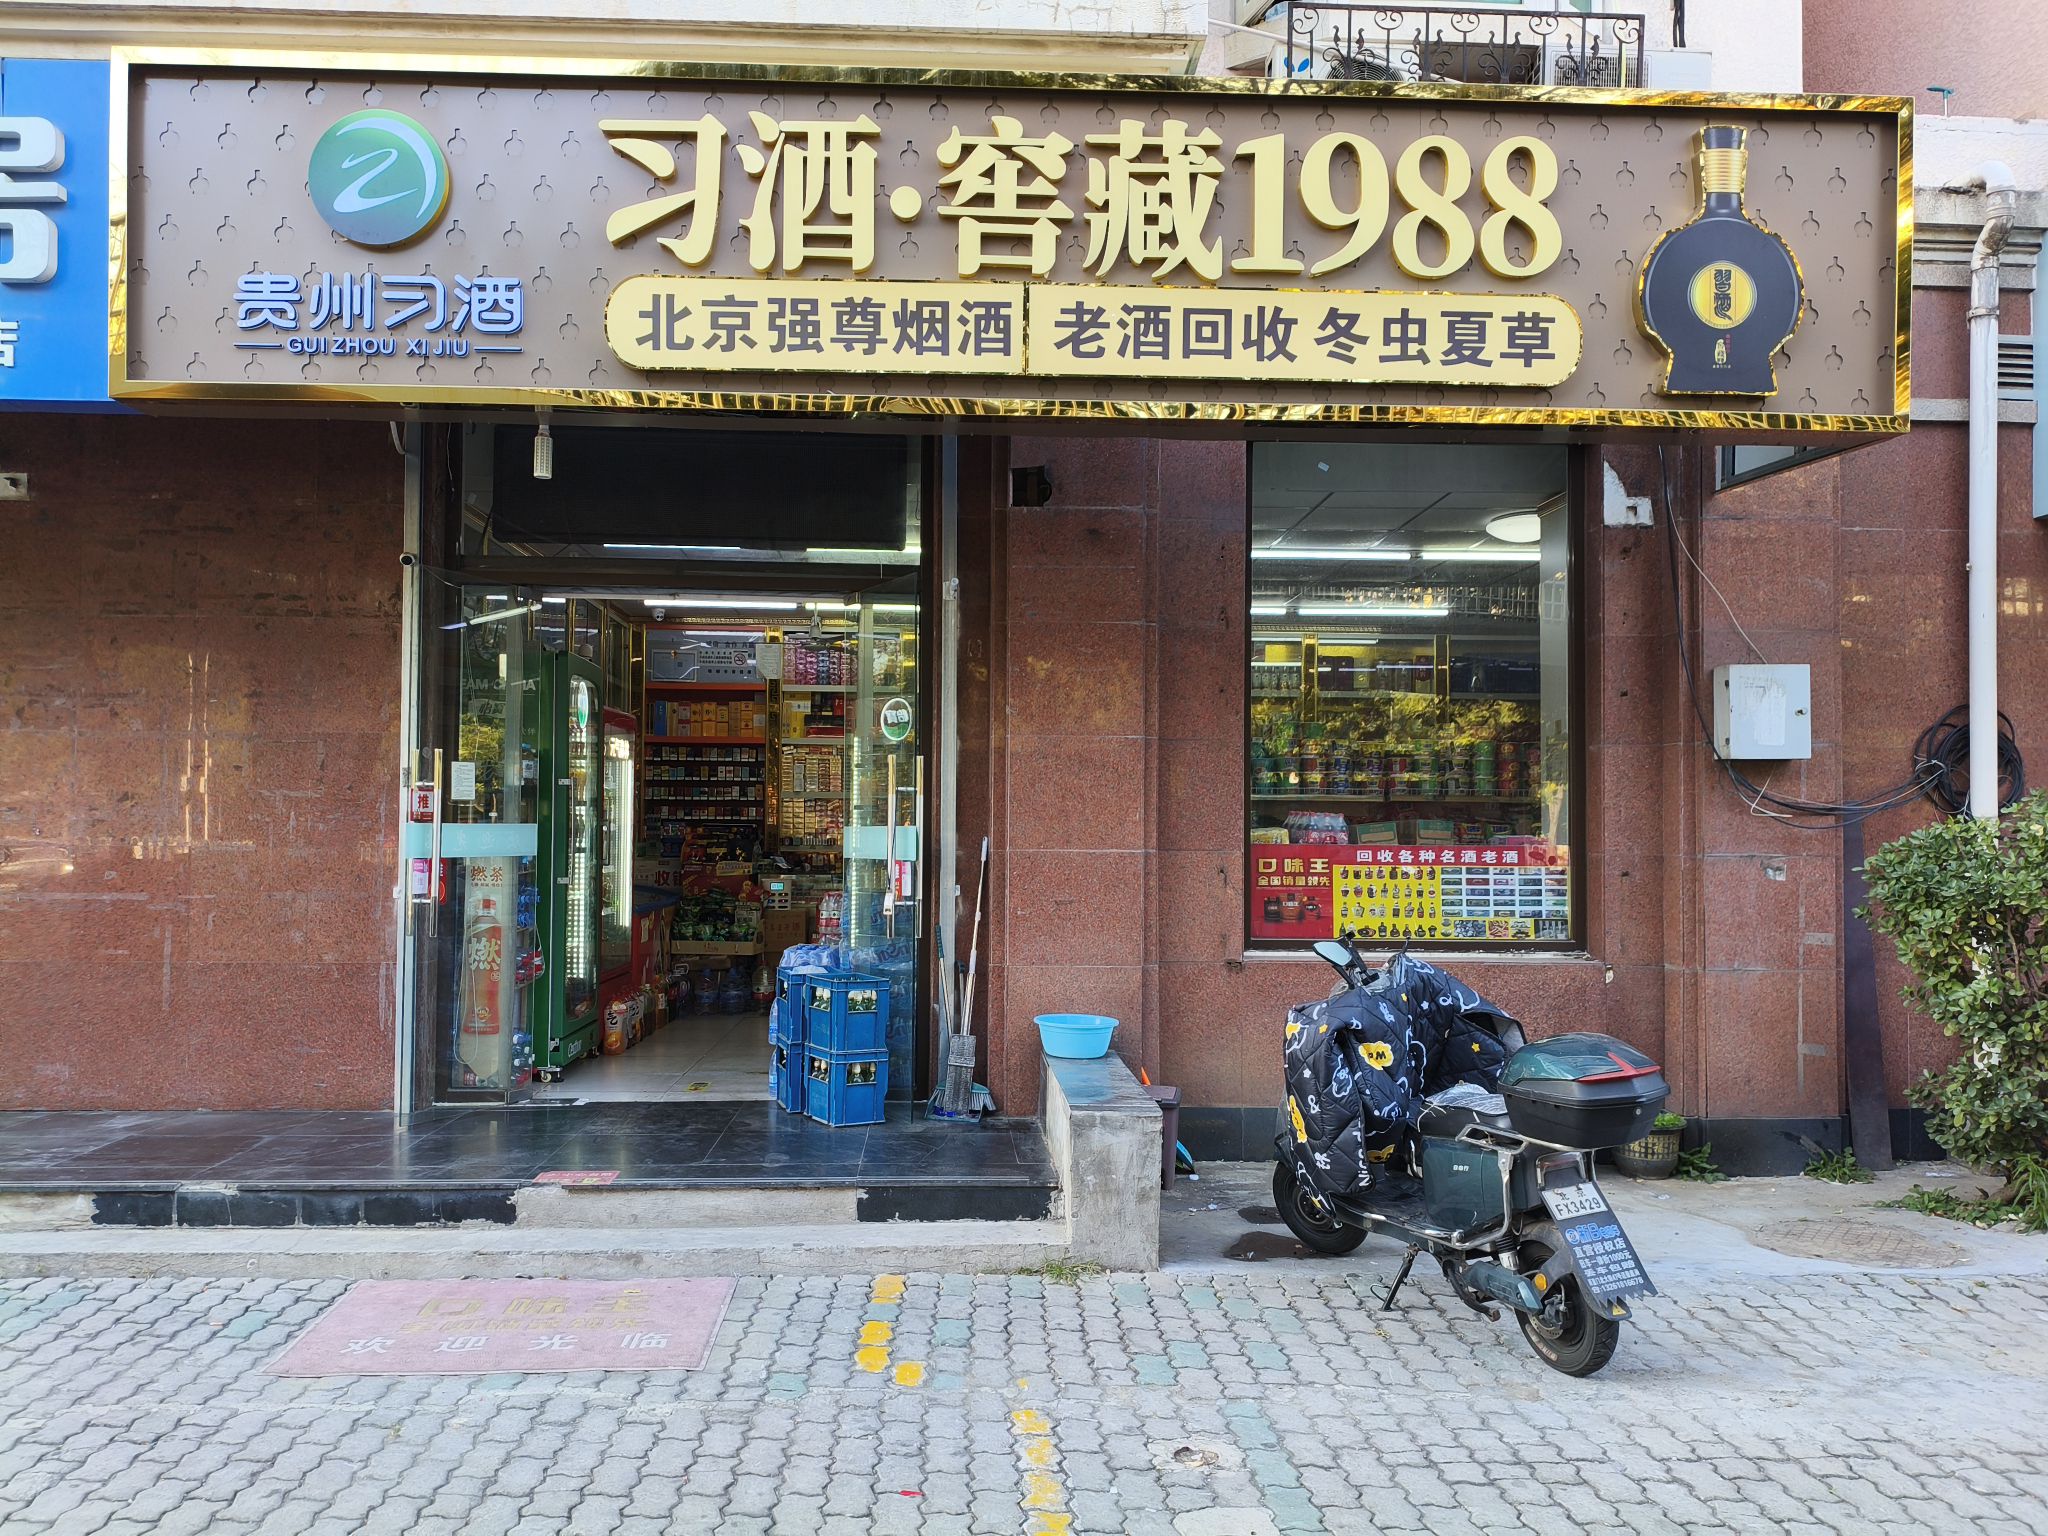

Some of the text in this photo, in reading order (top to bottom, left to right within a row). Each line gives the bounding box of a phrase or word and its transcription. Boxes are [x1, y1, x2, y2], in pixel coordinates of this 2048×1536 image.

[233, 272, 523, 335] 贵州习酒
[635, 293, 1014, 357] 北京强尊烟酒
[417, 793, 430, 810] 推
[1258, 857, 1330, 874] 口味王
[1356, 850, 1519, 864] 回收各种名酒老酒
[1257, 875, 1331, 887] 全国销量领先
[1555, 1197, 1602, 1217] FX3429
[340, 1333, 673, 1354] 欢迎光临
